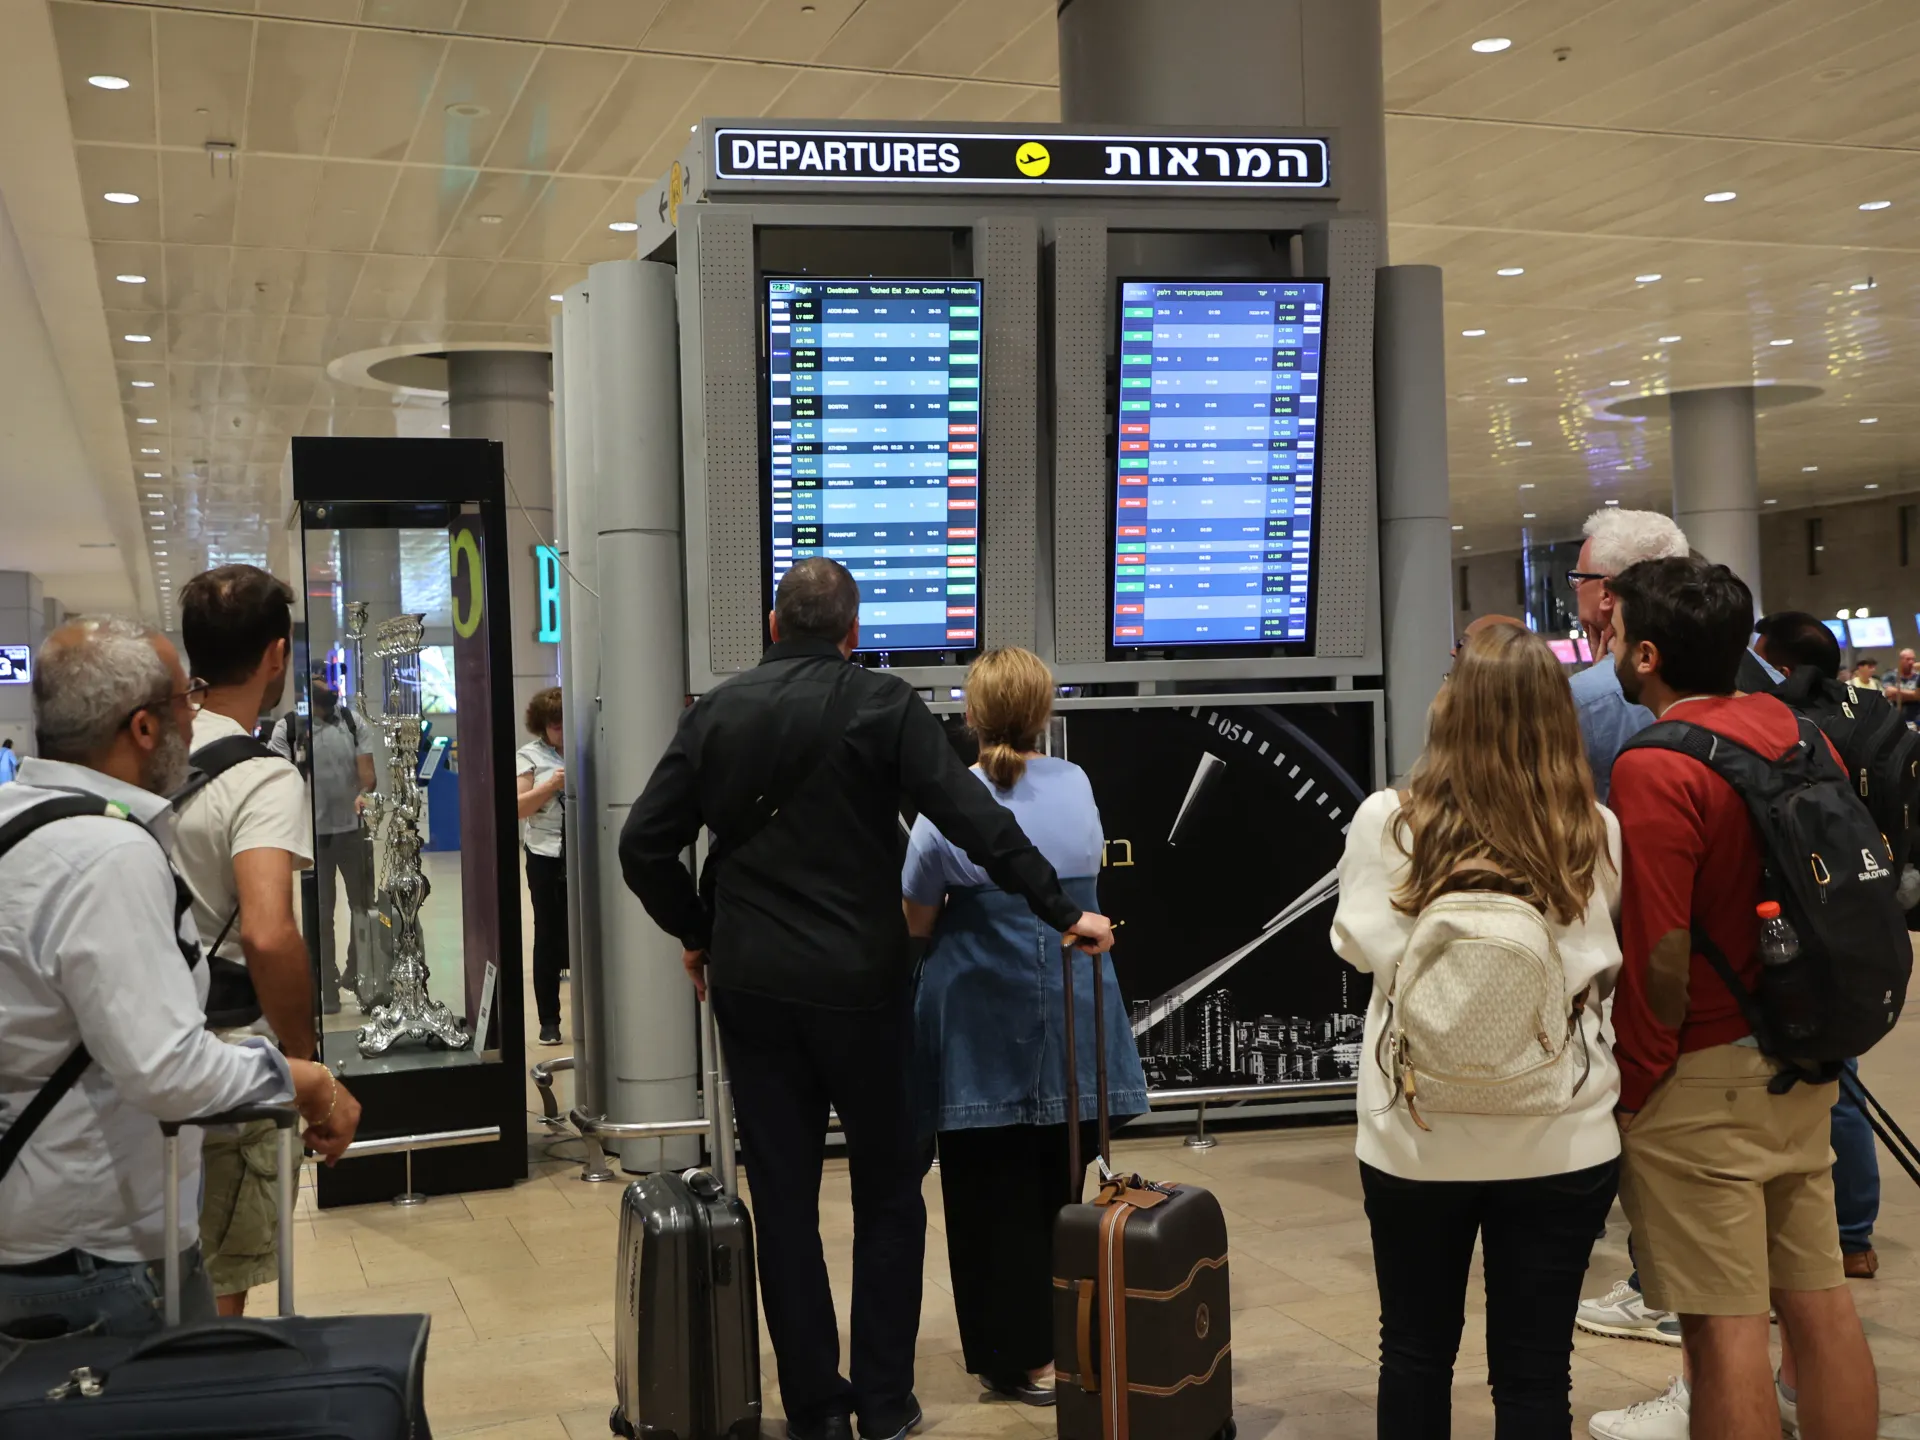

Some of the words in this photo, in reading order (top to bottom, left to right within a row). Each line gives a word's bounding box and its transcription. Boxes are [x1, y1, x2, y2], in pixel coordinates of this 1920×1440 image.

[731, 138, 961, 174] DEPARTURES
[1104, 144, 1309, 179] המראות
[1218, 718, 1243, 741] 05
